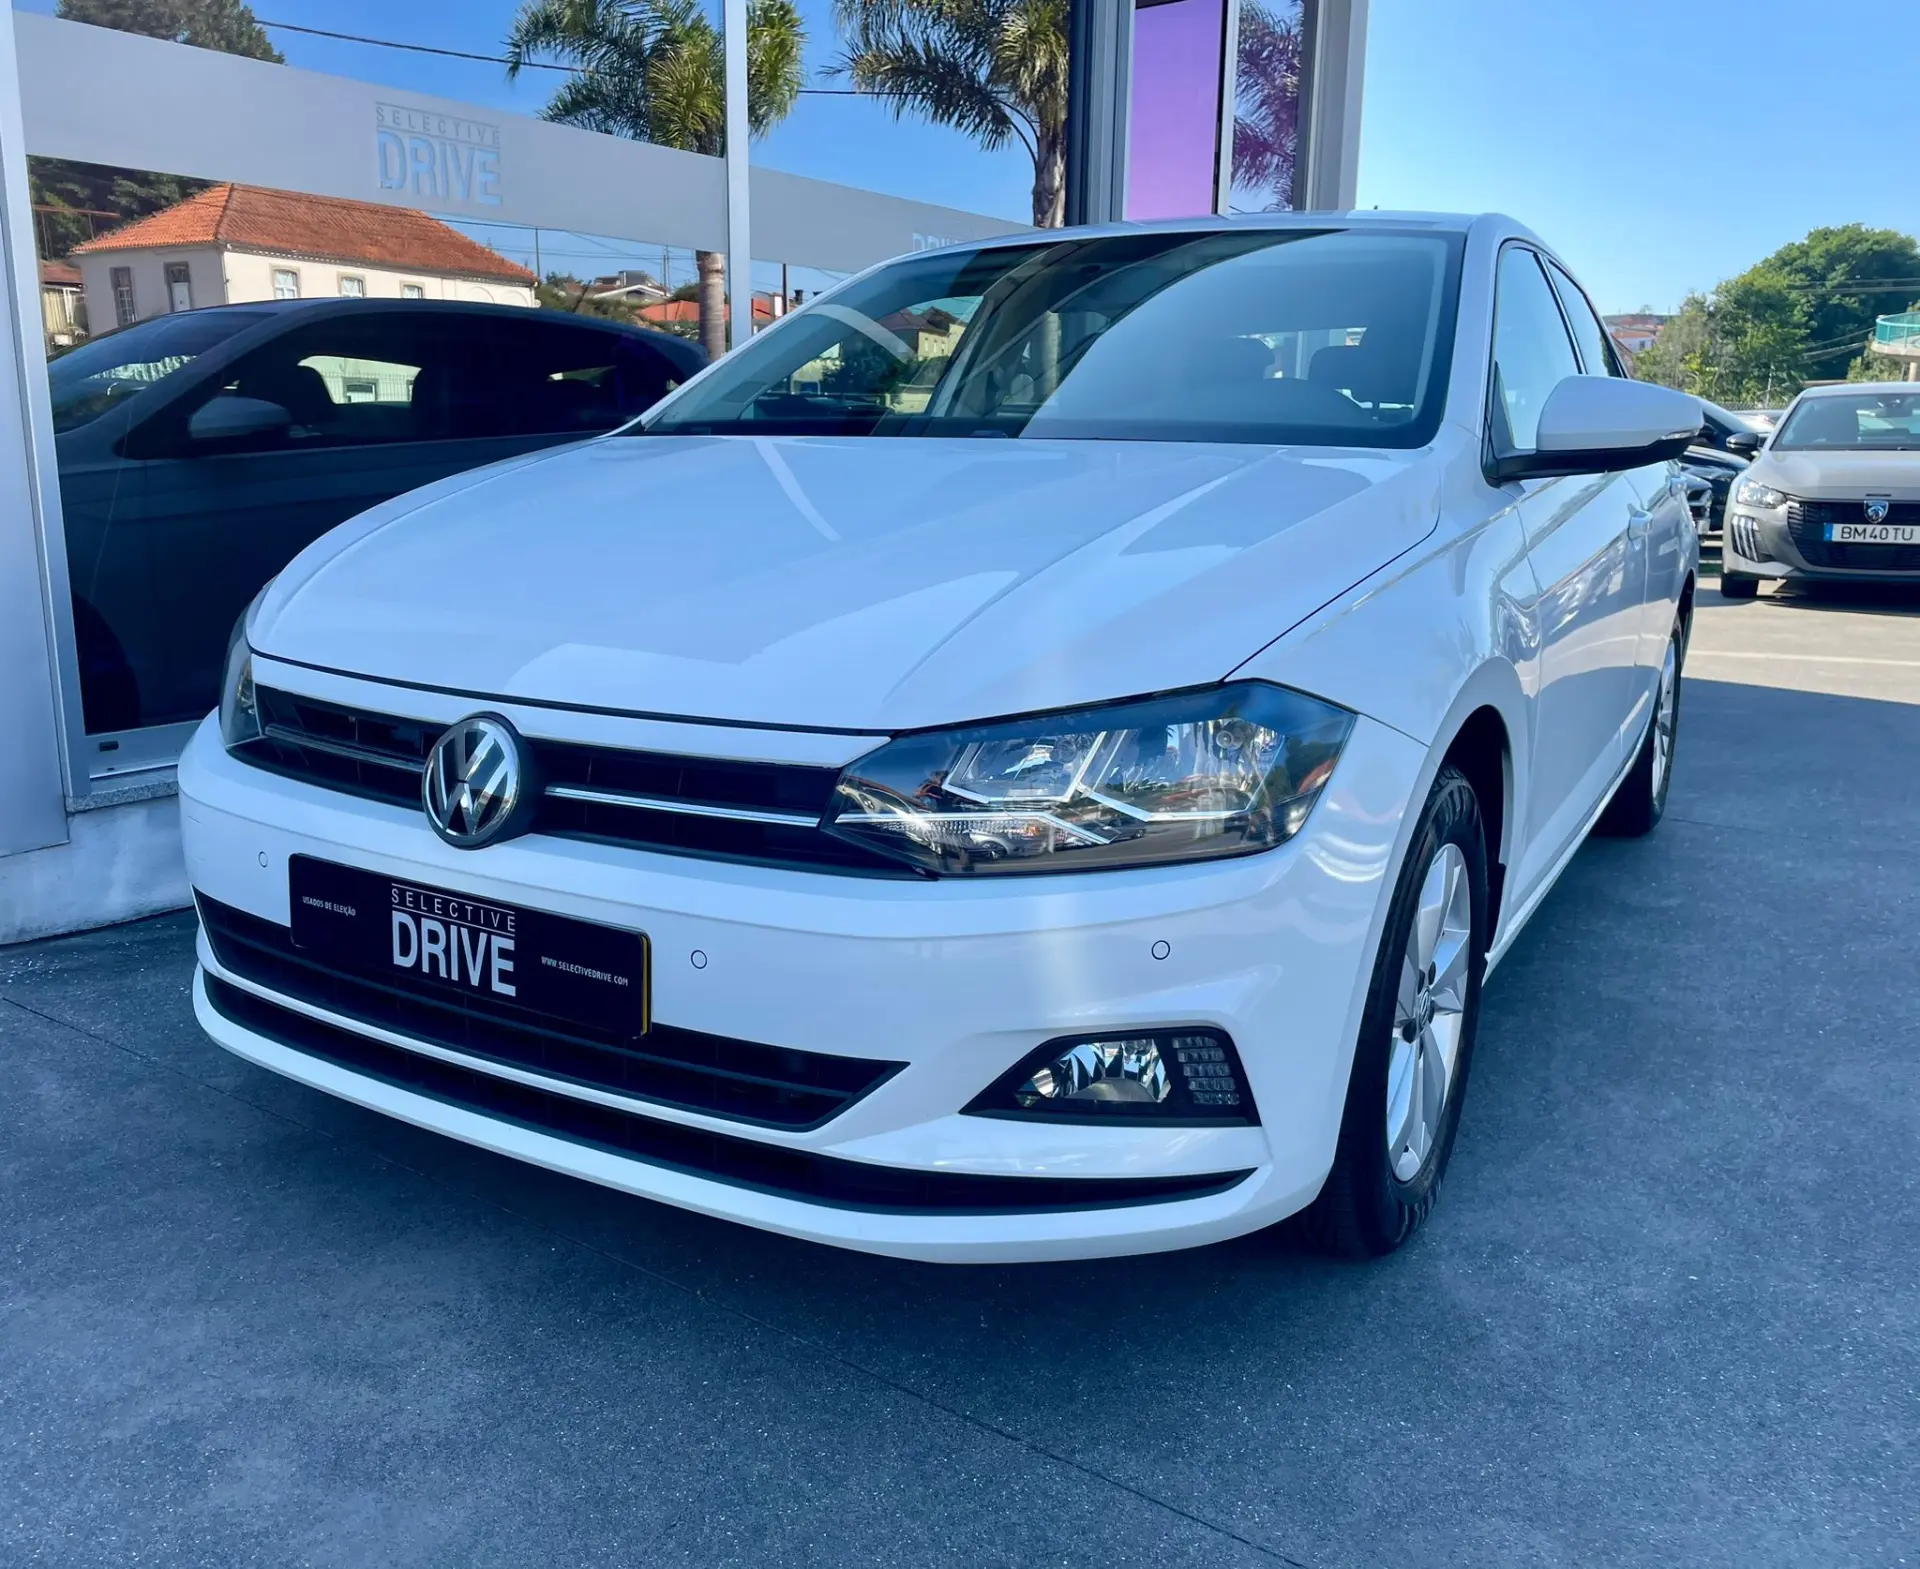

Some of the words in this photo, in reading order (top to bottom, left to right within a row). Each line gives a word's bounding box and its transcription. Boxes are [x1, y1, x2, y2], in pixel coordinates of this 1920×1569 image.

[376, 106, 500, 145] SELECTIVE
[377, 129, 502, 205] DRIVE
[302, 895, 324, 908] USADOS
[324, 901, 332, 910] DE
[391, 888, 515, 932] SELECTIVE
[391, 910, 517, 997] DRIVE
